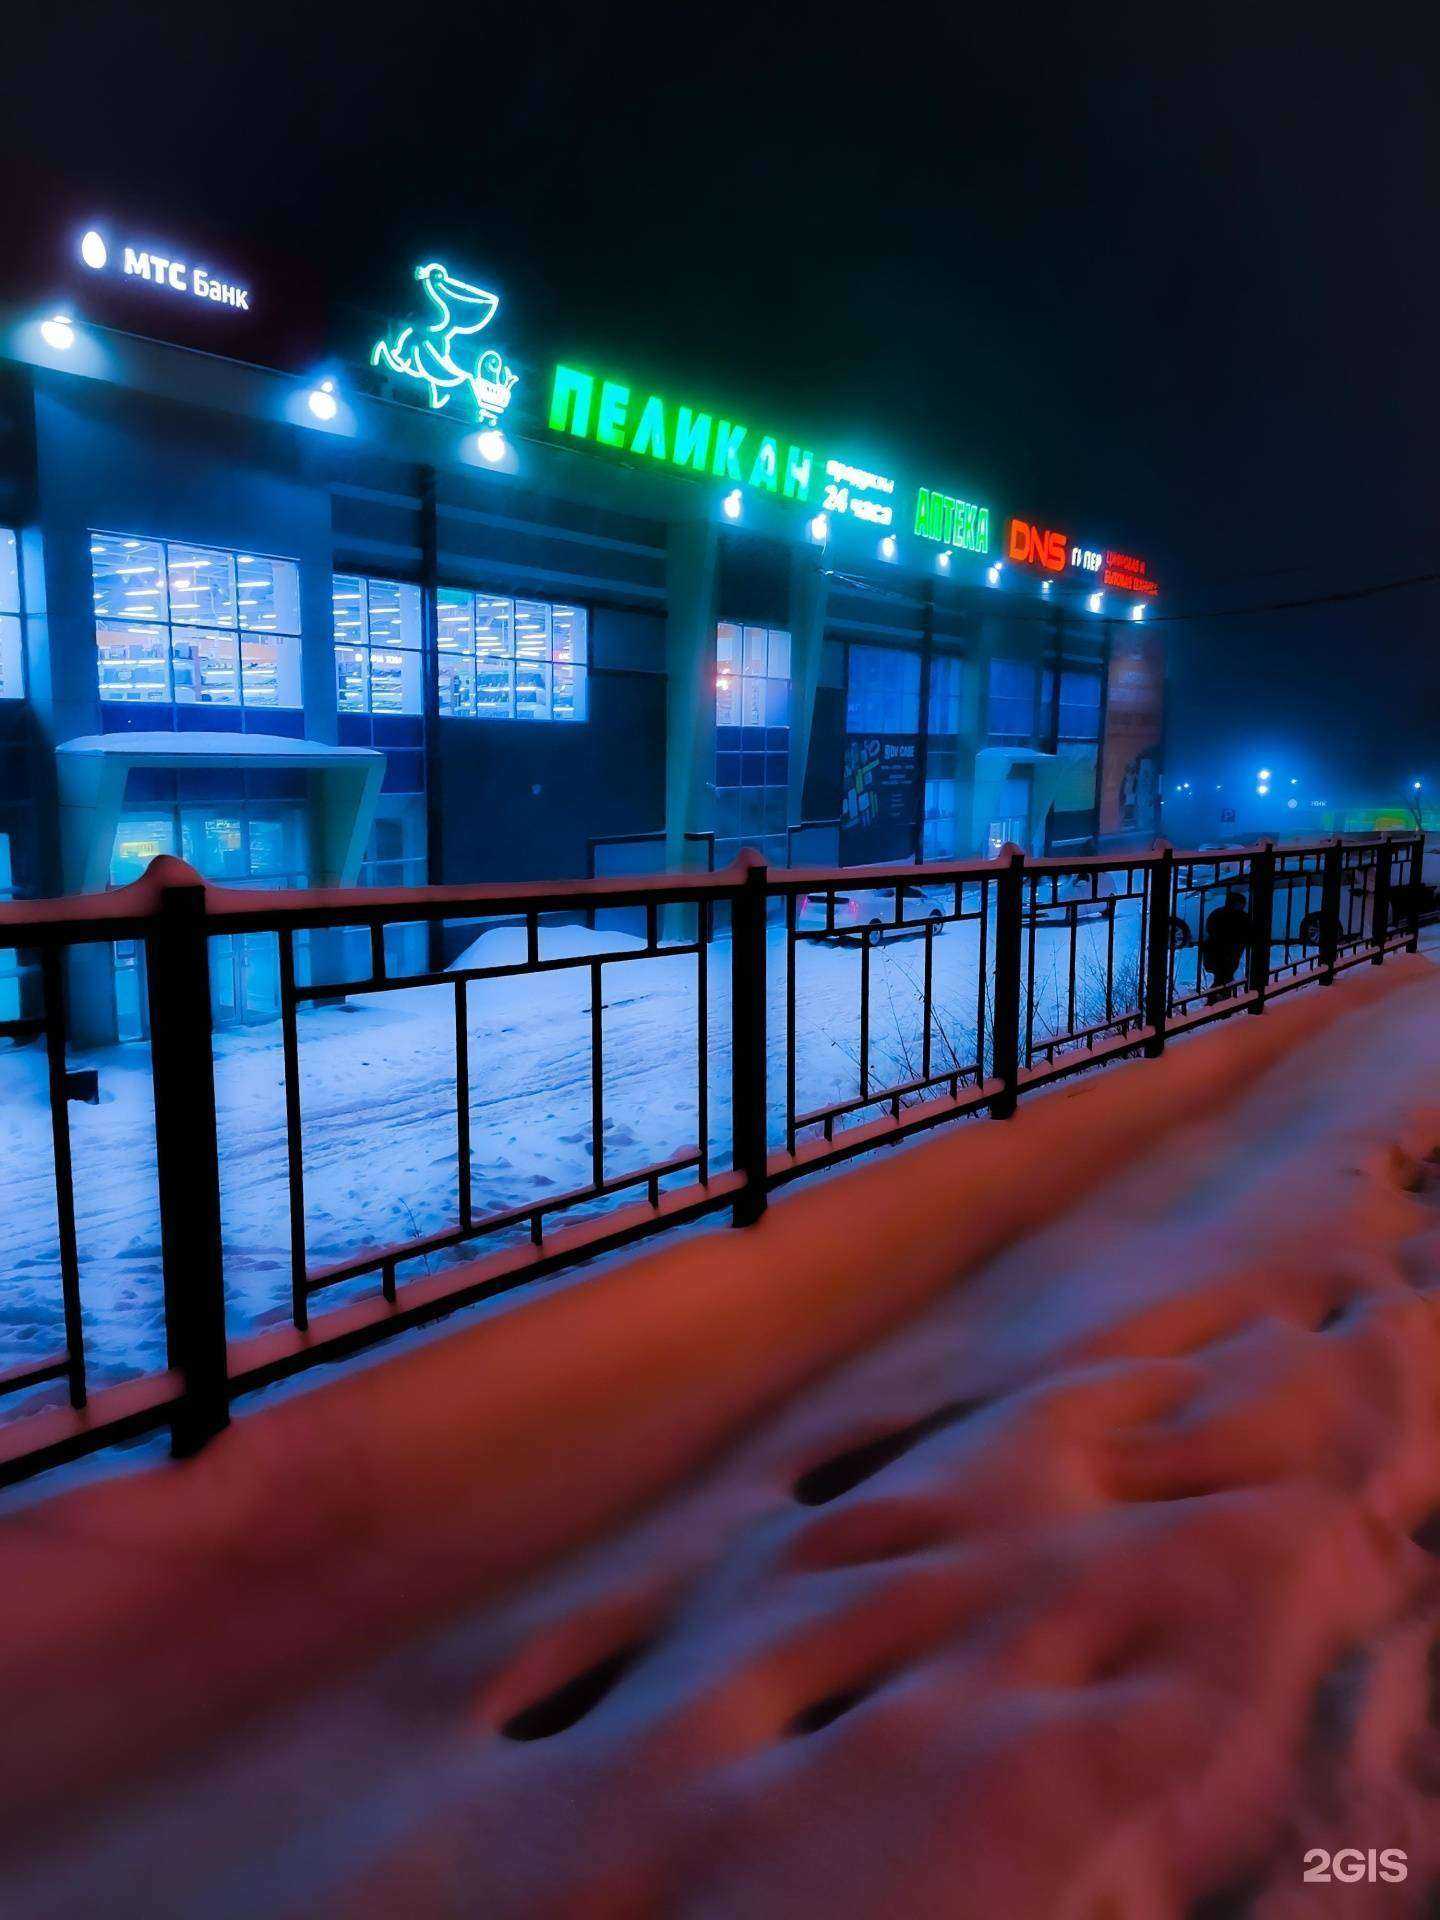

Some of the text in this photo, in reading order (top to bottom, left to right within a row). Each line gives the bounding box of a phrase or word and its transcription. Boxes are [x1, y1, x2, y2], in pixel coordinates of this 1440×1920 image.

[124, 248, 249, 310] МТС Банк
[548, 364, 814, 501] ПЕЛИКАН
[823, 485, 848, 513] 24
[914, 487, 989, 554] АПТЕКА
[1009, 518, 1067, 572] DNS
